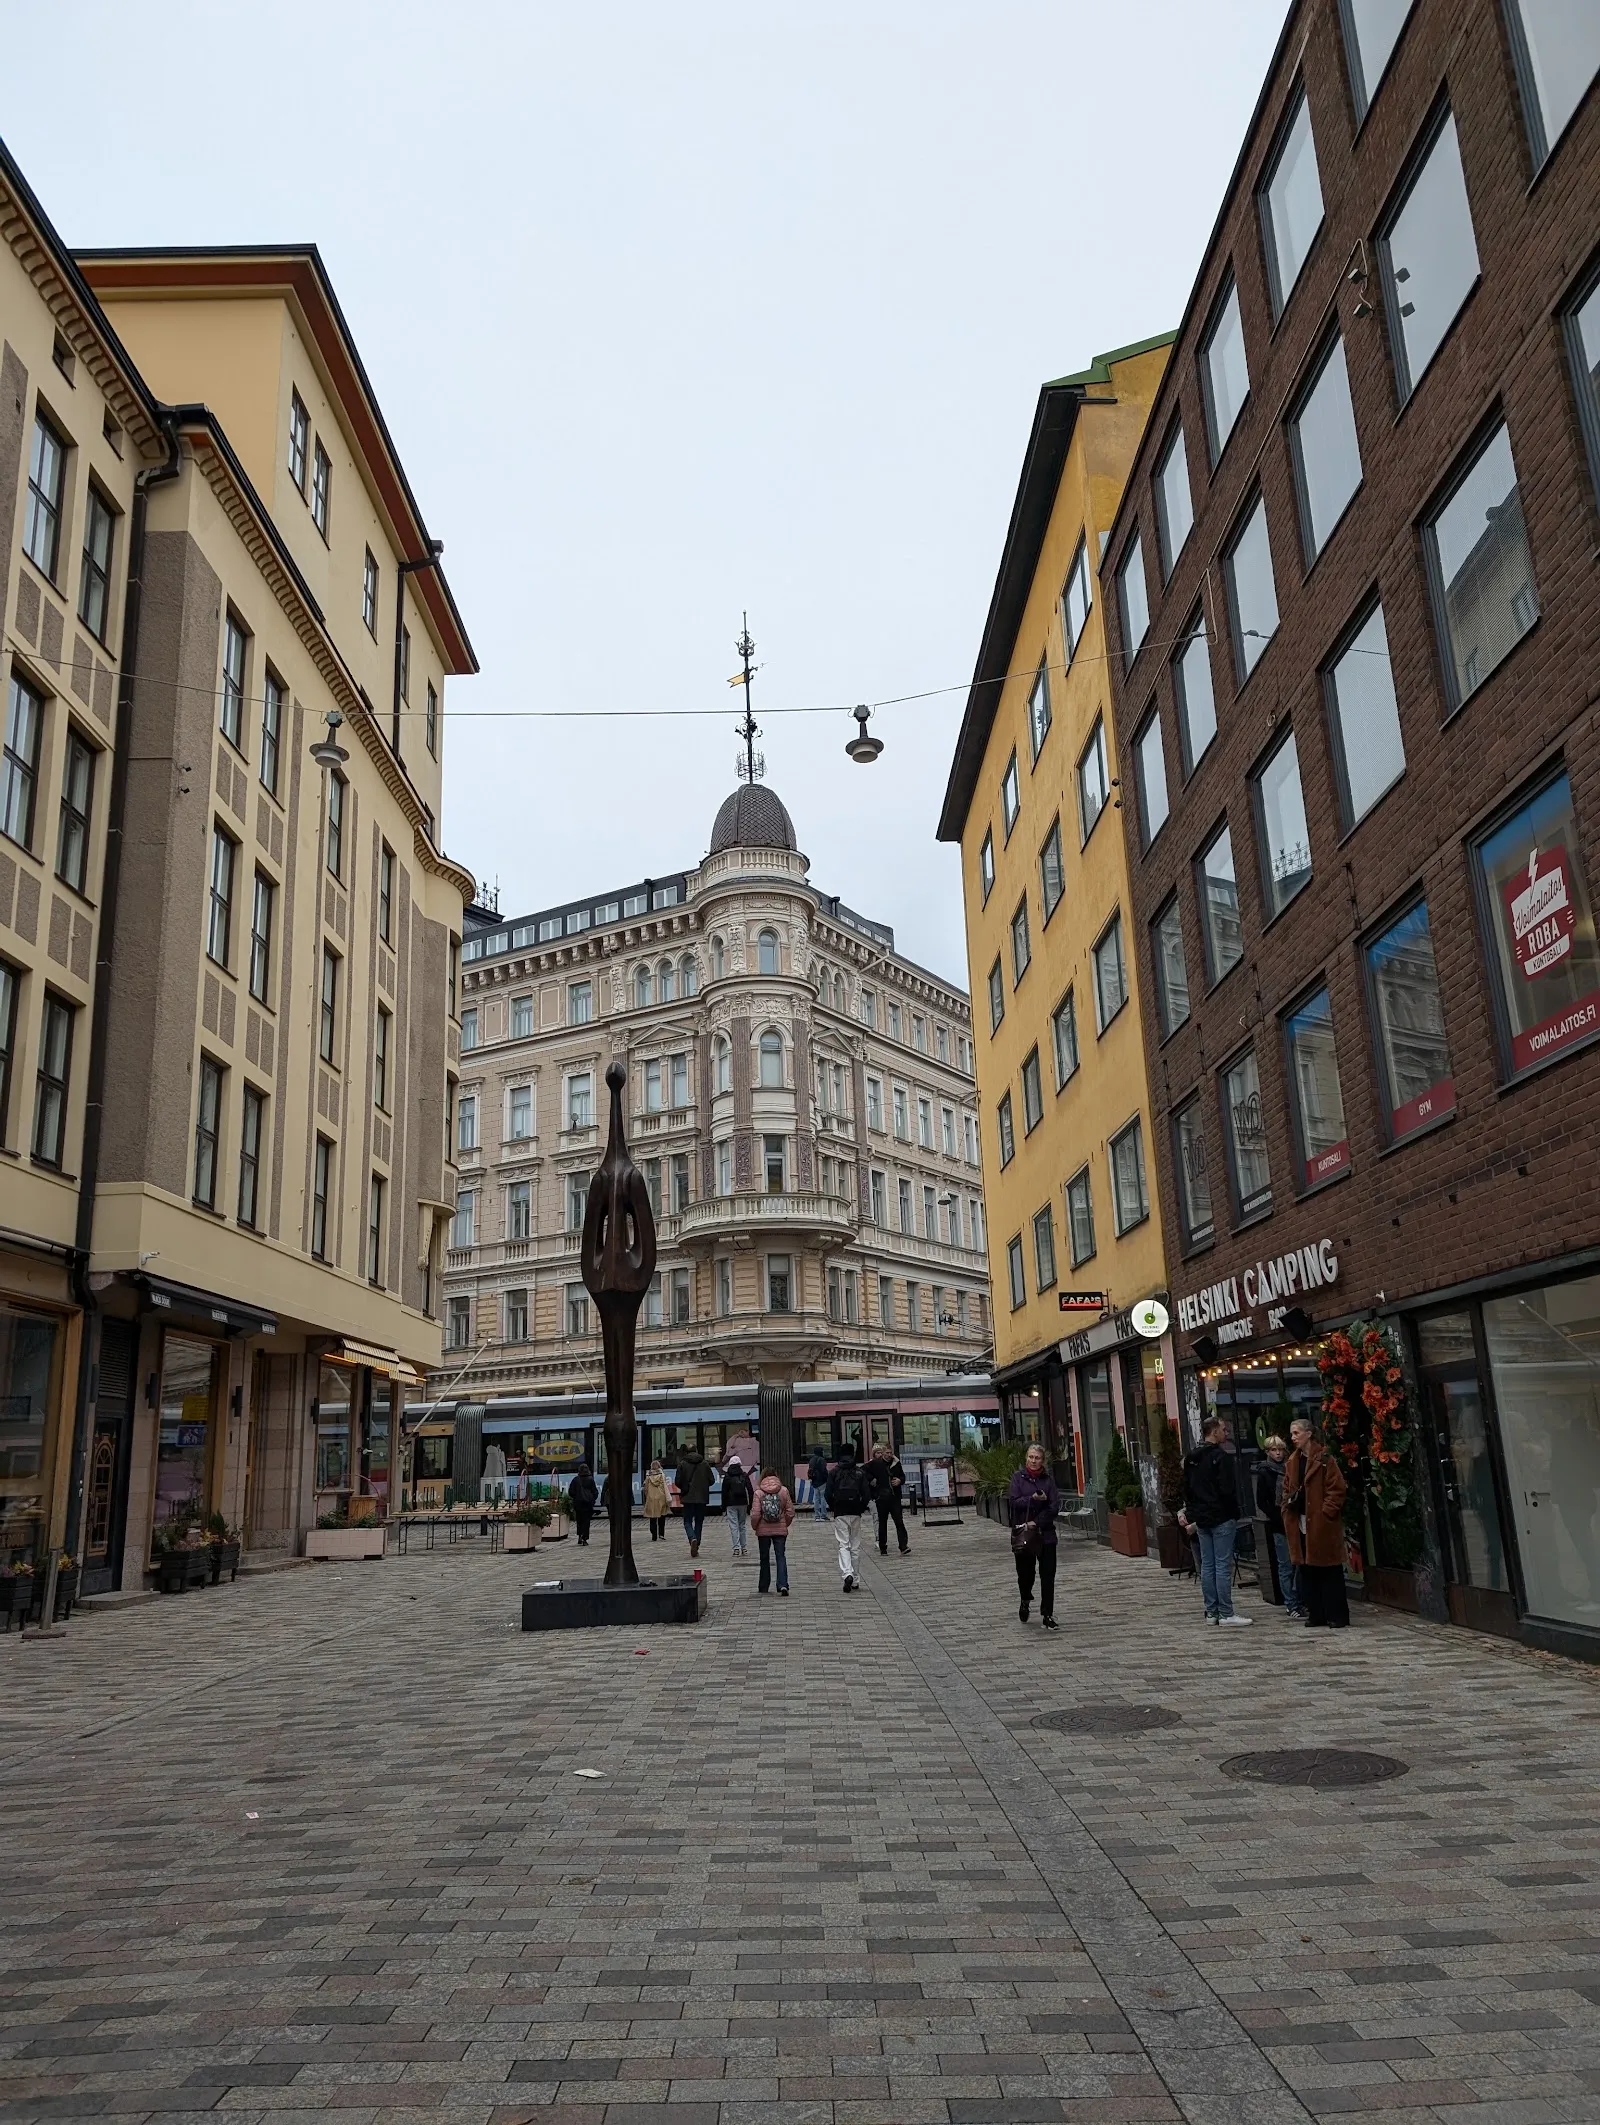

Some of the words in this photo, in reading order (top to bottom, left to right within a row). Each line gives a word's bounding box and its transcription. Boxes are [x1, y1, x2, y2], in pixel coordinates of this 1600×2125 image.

[1515, 876, 1562, 935] Voimalaitos
[1527, 917, 1560, 955] ROBA
[1529, 1004, 1596, 1052] VOIMALAITOS.FI
[1418, 1099, 1432, 1116] GYM
[1177, 1276, 1241, 1332] HELSINKI
[1243, 1238, 1339, 1308] CAMPING
[1217, 1316, 1253, 1345] MINIGOLF
[964, 1415, 976, 1428] 10
[538, 1445, 581, 1456] IKEA
